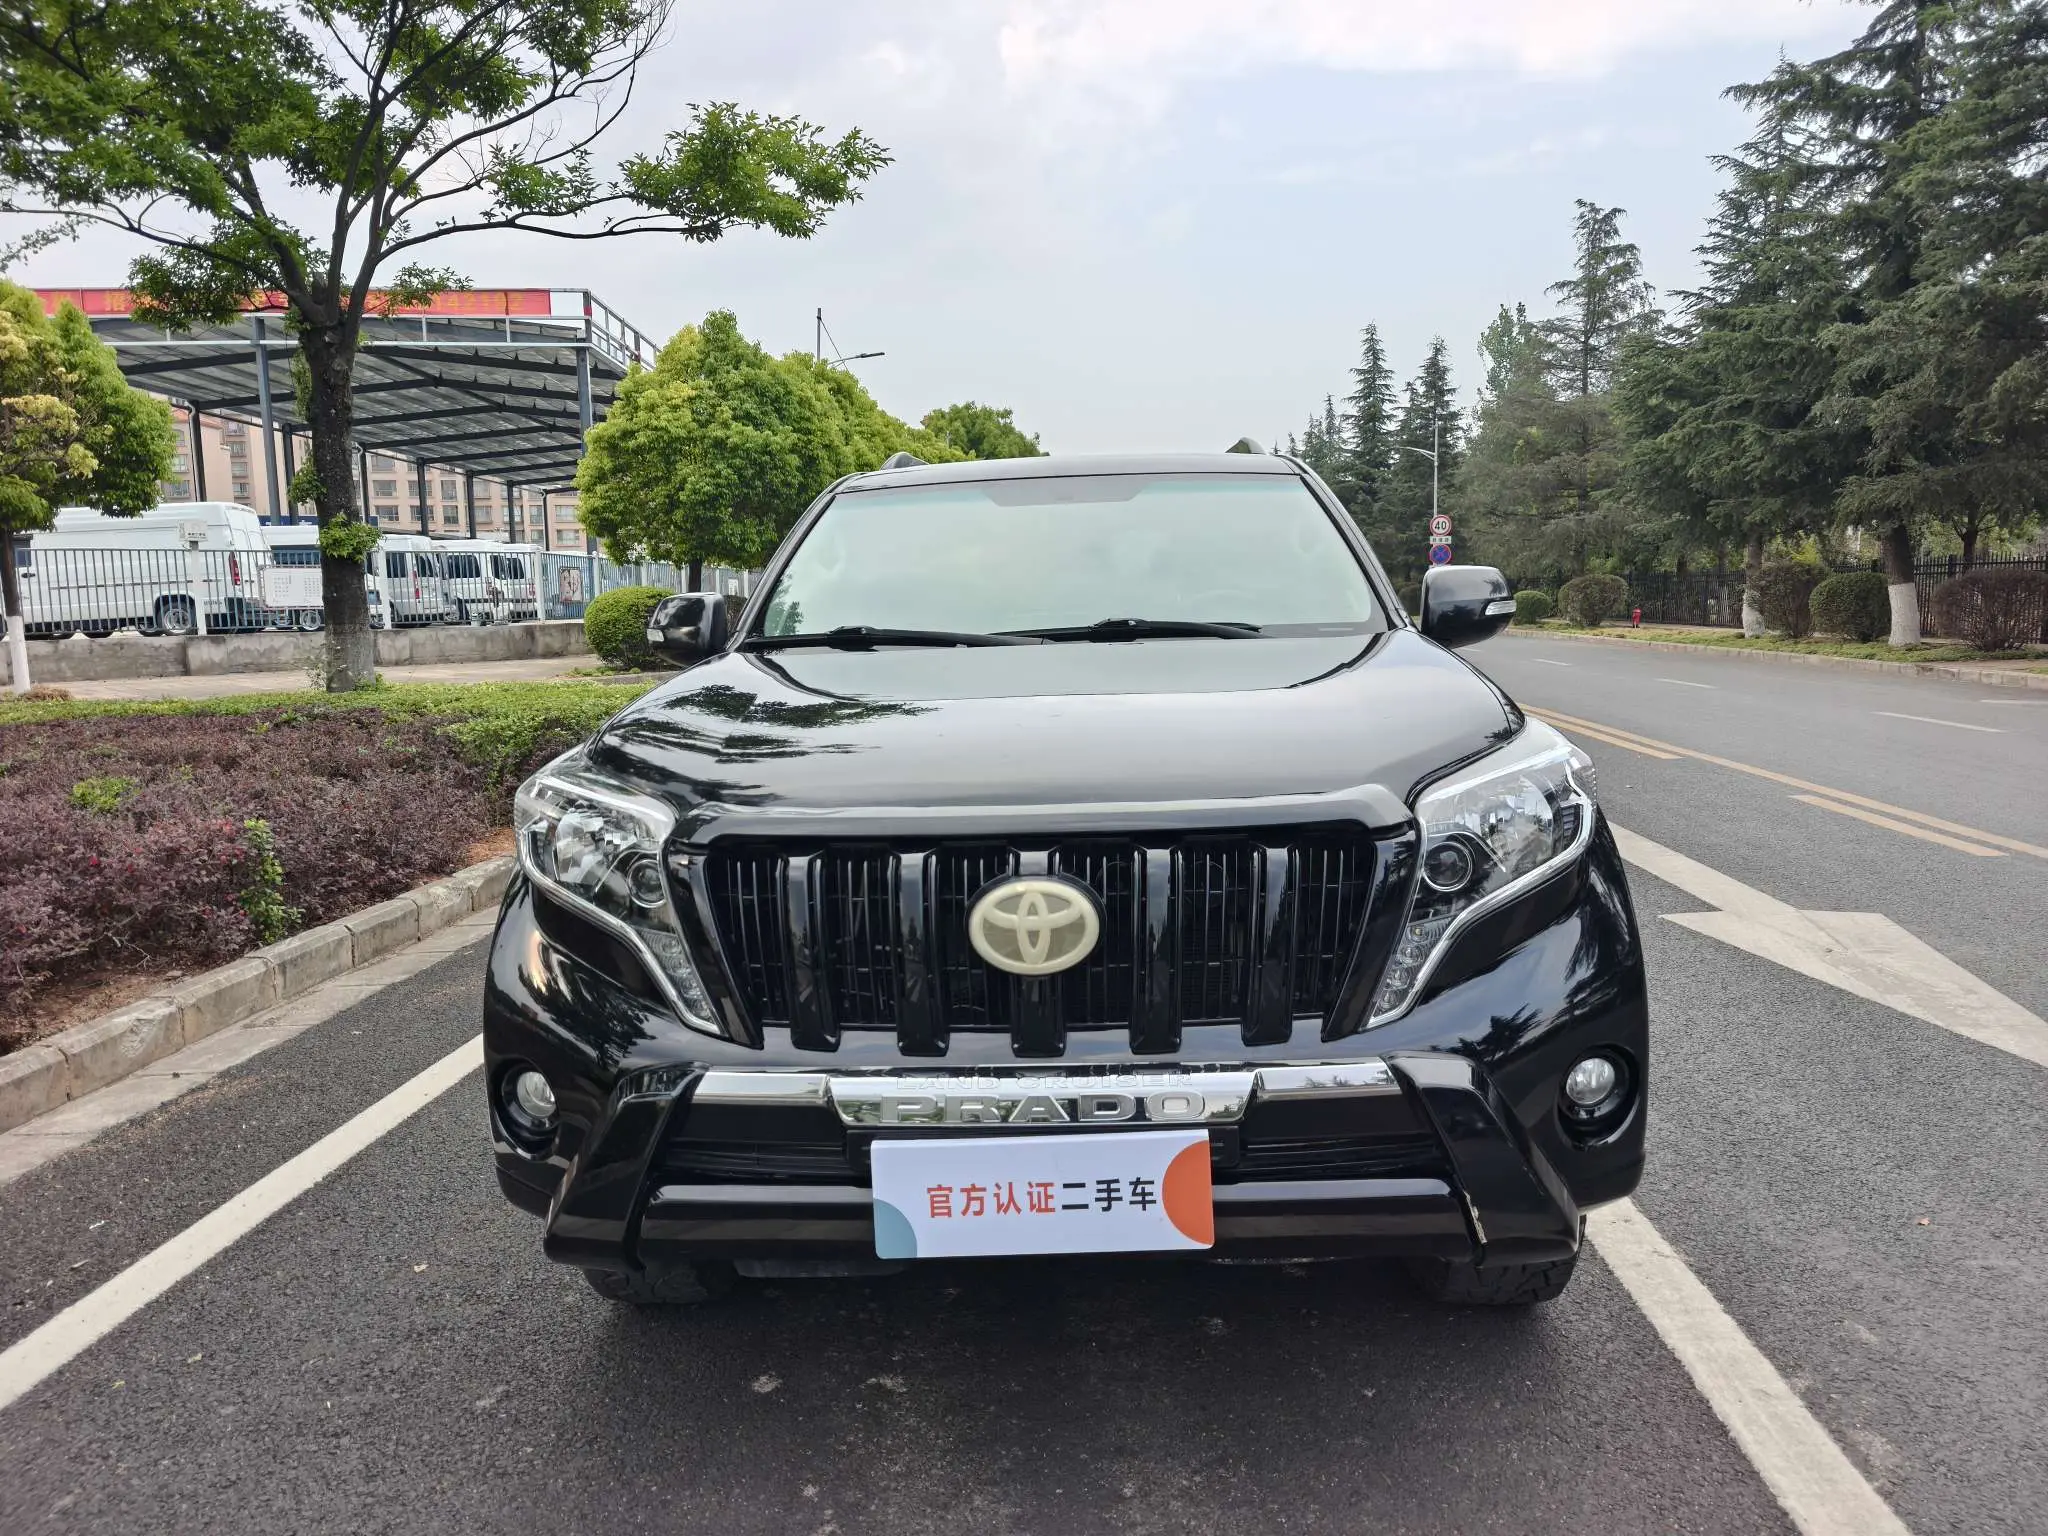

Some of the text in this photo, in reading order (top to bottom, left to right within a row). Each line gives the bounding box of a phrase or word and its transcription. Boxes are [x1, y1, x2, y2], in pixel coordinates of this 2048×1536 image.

[1434, 521, 1447, 530] 40
[896, 1072, 1193, 1090] LAND CRUISER
[880, 1092, 1206, 1122] PRADO
[926, 1177, 1158, 1218] 官方认证二手车
